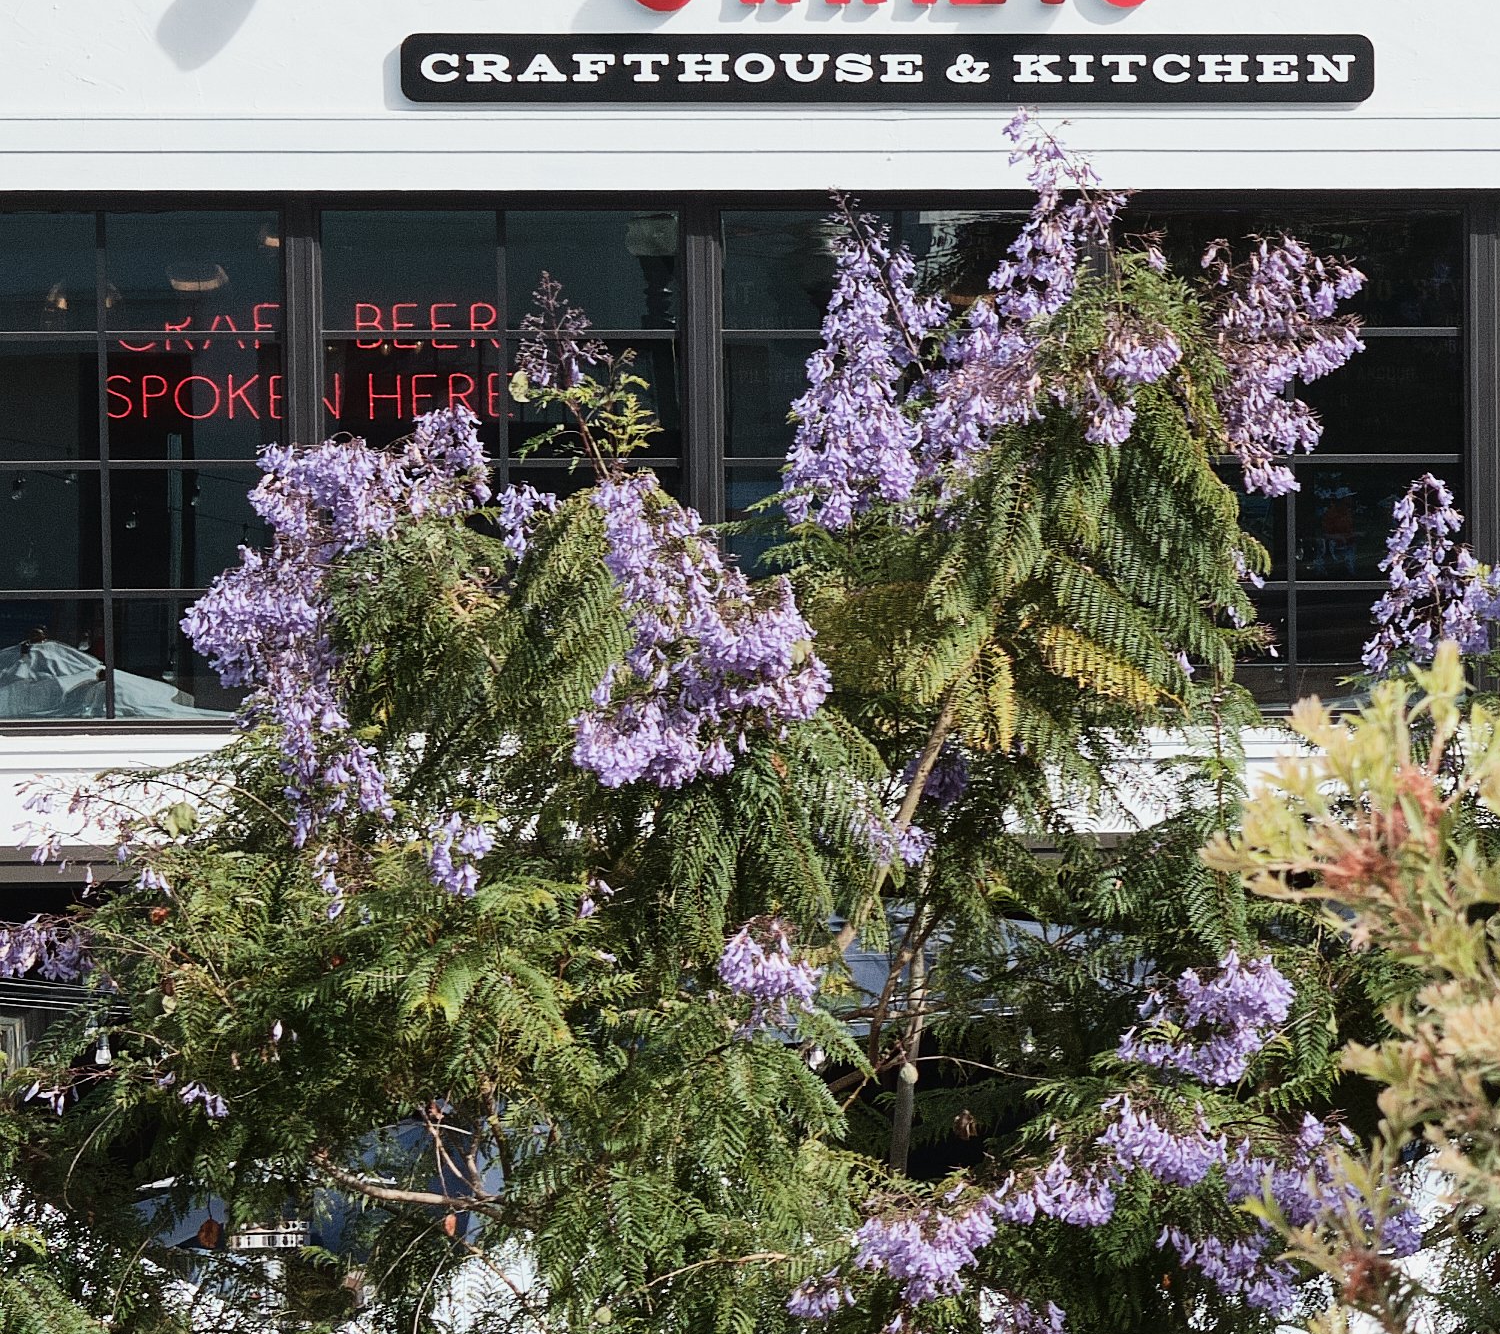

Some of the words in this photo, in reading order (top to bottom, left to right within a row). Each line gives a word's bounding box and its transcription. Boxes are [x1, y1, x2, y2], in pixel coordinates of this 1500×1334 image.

[420, 52, 924, 85] CRAFTHOUSE
[945, 53, 989, 85] &
[1011, 52, 1356, 84] KITCHEN
[355, 302, 499, 350] BEER
[368, 372, 515, 420] HERE
